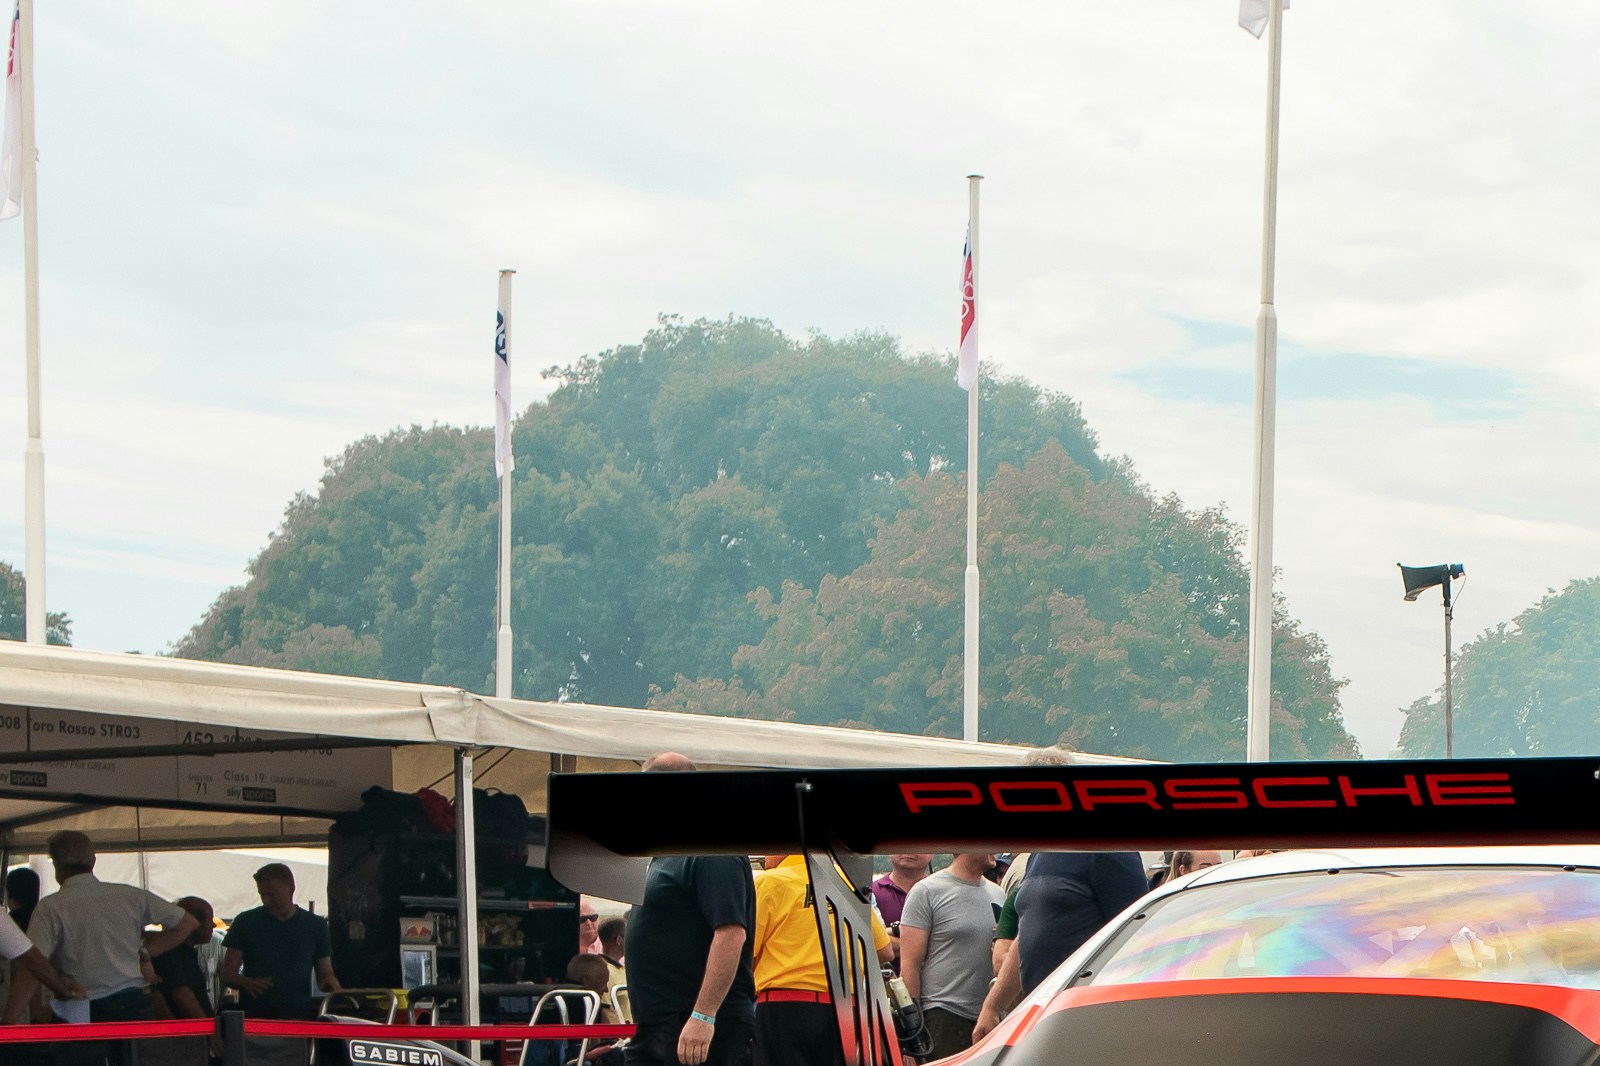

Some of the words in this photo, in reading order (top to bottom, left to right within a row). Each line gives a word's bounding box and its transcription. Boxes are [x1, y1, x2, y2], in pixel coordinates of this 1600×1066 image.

[25, 716, 54, 733] oro
[59, 720, 96, 736] Rosso
[100, 723, 140, 739] STR03
[12, 773, 46, 785] sports
[224, 770, 250, 782] Class
[195, 782, 208, 795] 71
[226, 787, 241, 799] sky
[244, 787, 275, 800] sports
[899, 772, 1515, 814] PORSCHE
[354, 1045, 439, 1066] SABIEM
